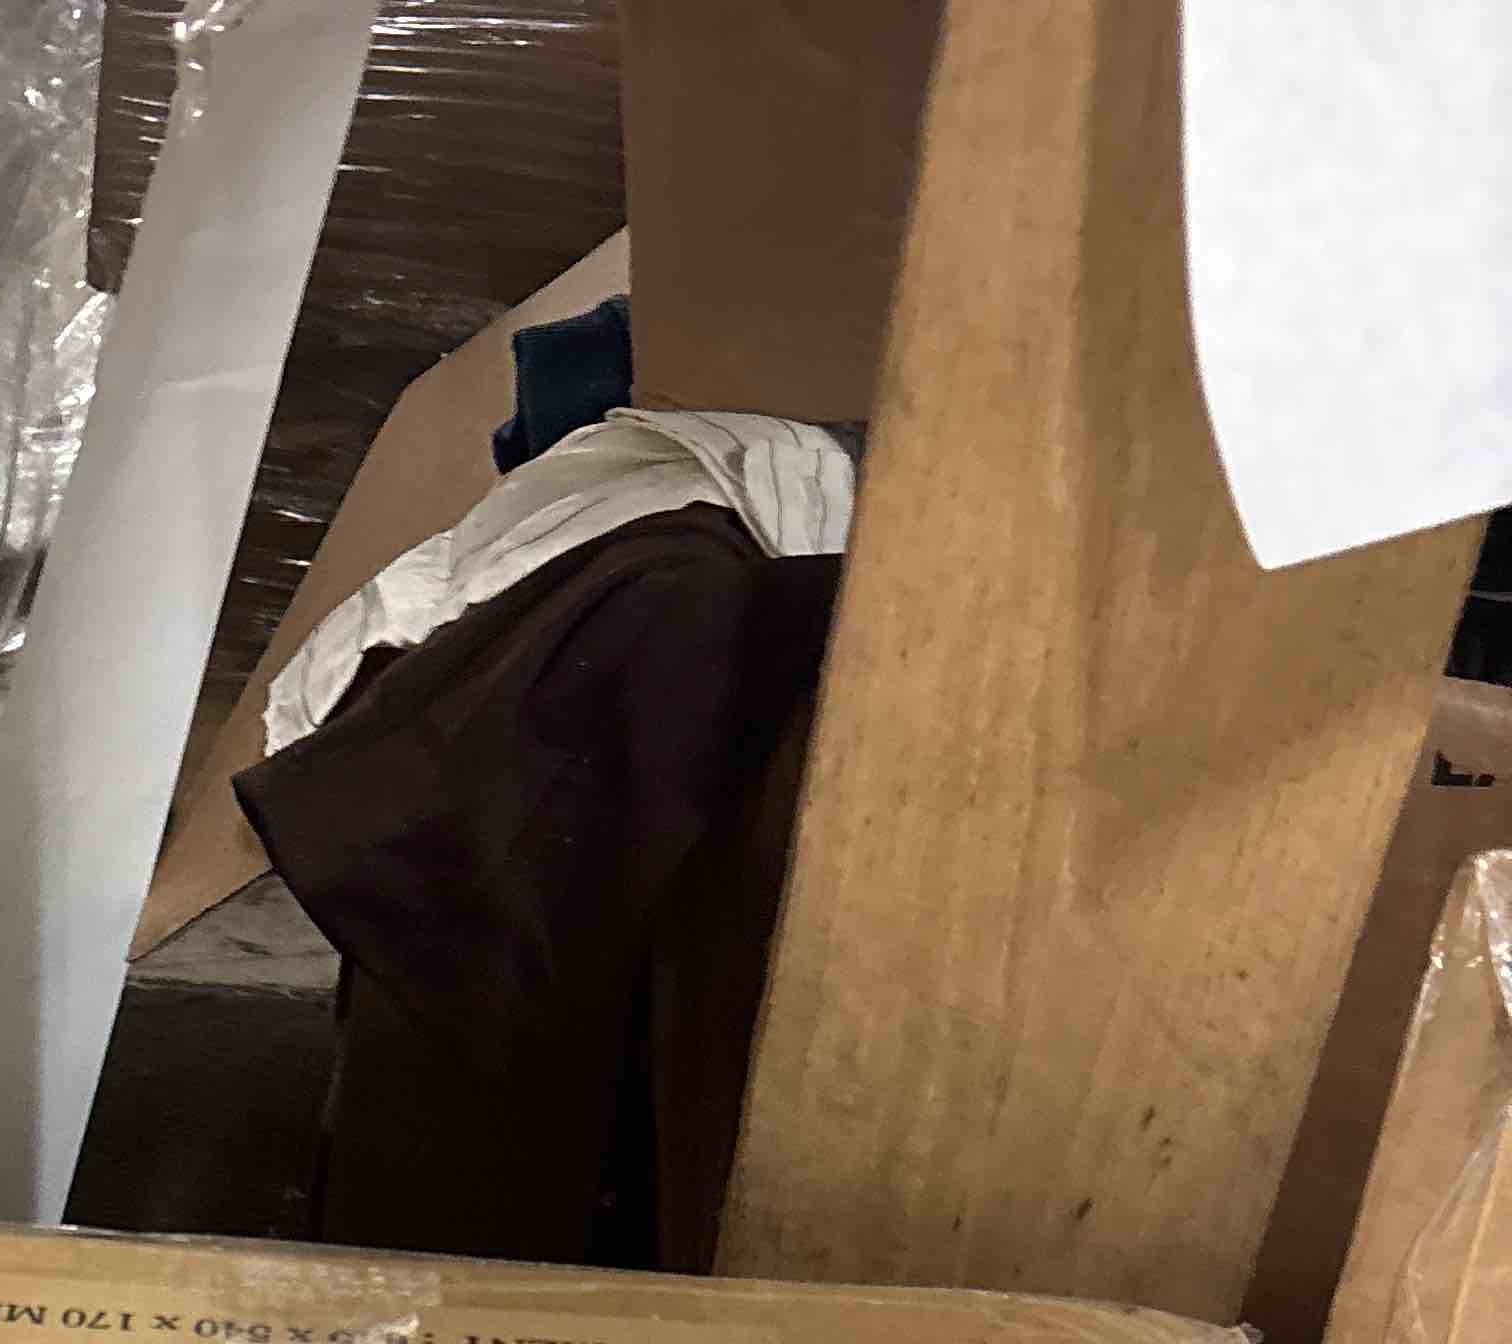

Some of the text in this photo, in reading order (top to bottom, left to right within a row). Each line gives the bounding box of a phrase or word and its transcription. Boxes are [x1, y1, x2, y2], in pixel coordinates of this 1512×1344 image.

[61, 1308, 133, 1332] 170
[151, 1314, 181, 1332] x
[194, 1317, 272, 1343] 540
